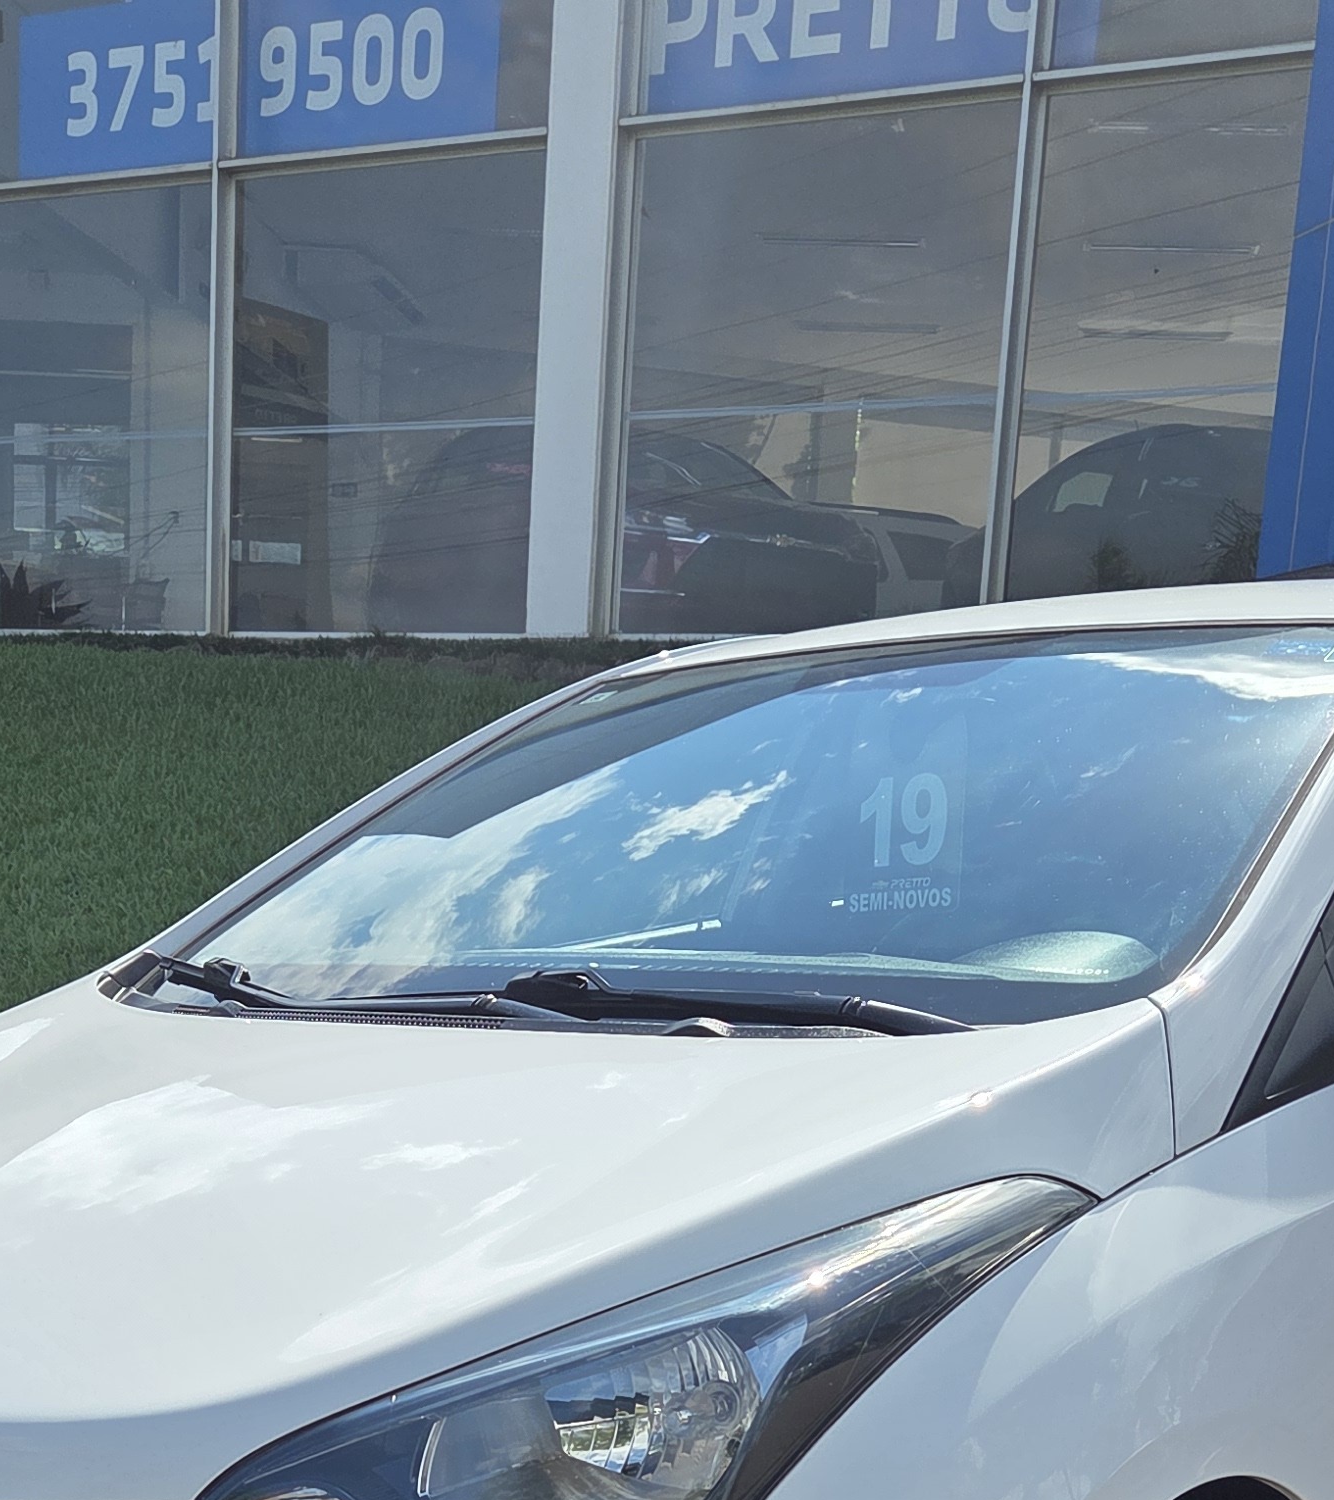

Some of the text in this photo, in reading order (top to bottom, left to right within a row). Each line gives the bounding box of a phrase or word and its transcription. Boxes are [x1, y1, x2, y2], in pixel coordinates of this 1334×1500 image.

[66, 7, 444, 137] 3751 9500
[860, 772, 948, 868] 19
[890, 876, 931, 888] PRETTO
